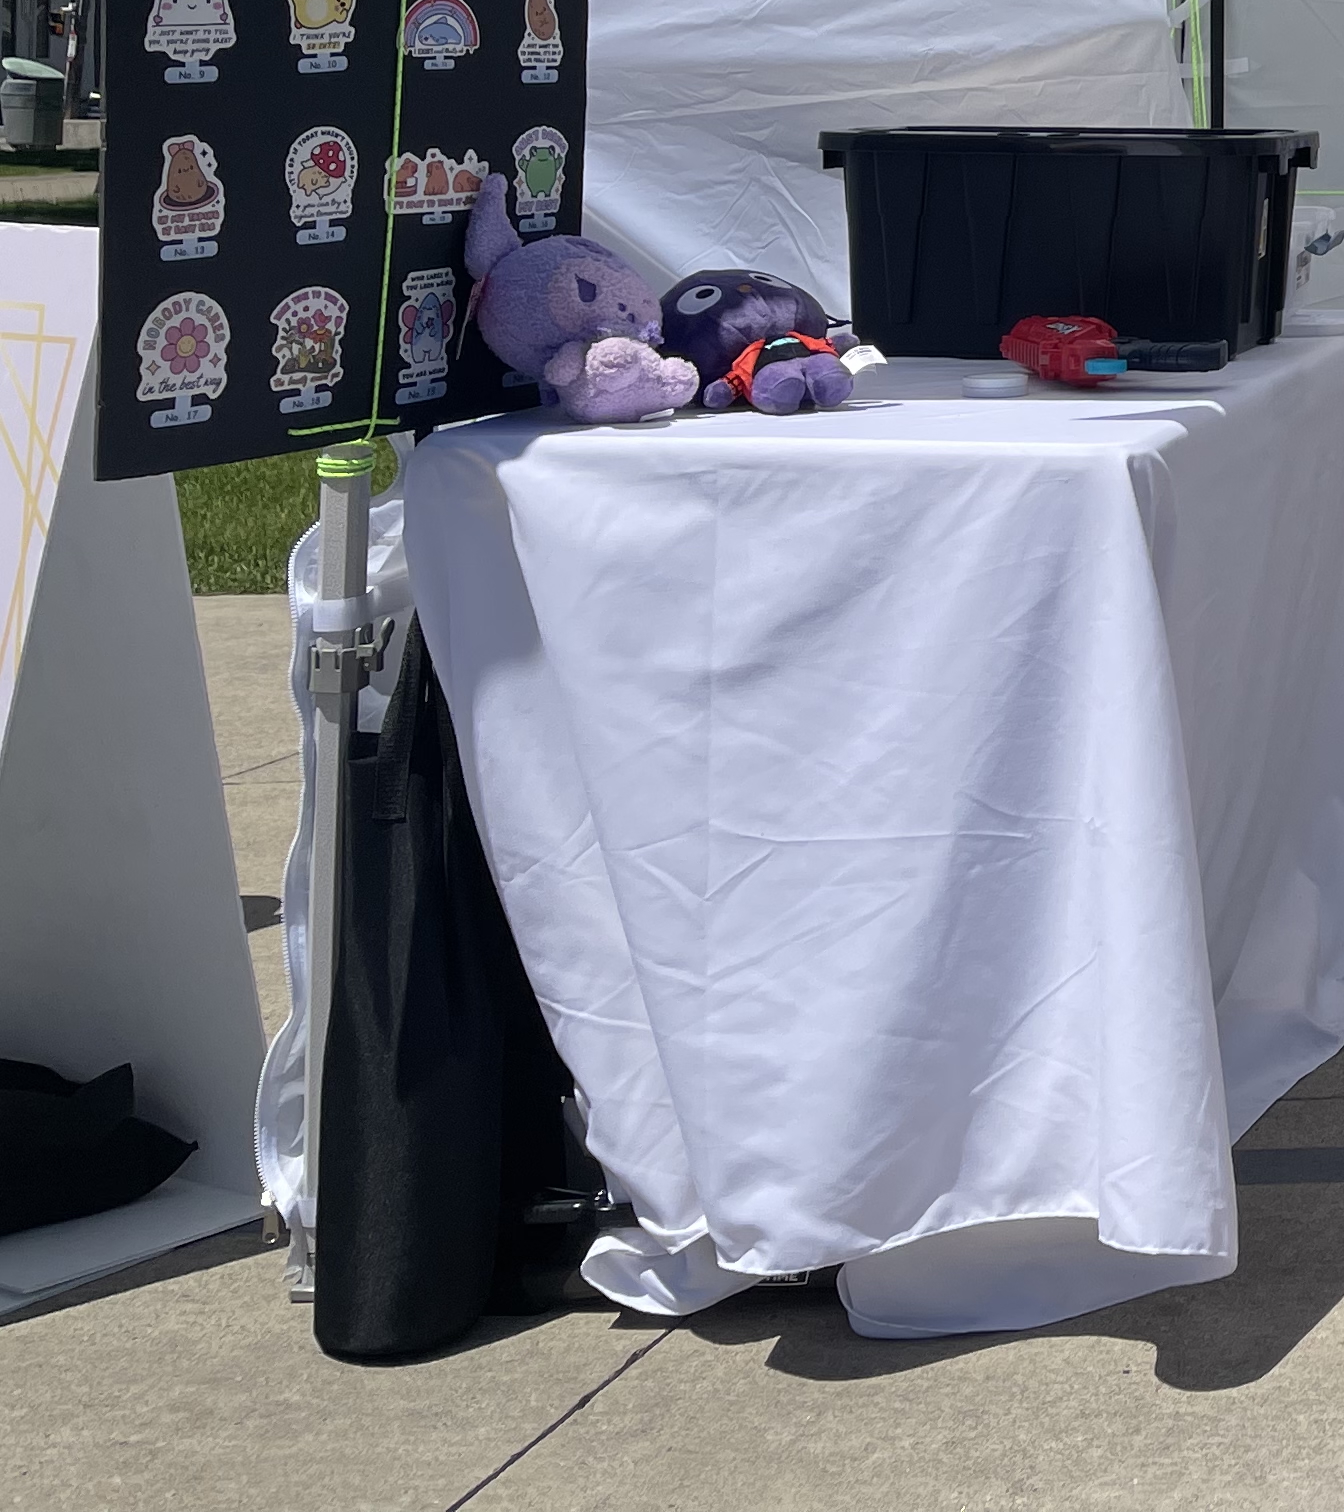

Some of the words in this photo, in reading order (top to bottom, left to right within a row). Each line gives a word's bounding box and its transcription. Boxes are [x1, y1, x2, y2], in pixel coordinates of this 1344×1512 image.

[309, 62, 322, 70] No.
[327, 60, 337, 69] 10
[178, 71, 193, 80] No.
[199, 70, 205, 79] 9
[297, 130, 319, 147] TODAY
[308, 233, 321, 241] No.
[325, 230, 335, 239] 14
[143, 297, 193, 351] NOBODY
[195, 299, 226, 344] CARES
[142, 382, 156, 396] in
[157, 376, 177, 394] the
[177, 373, 204, 391] best
[204, 377, 223, 394] way
[164, 414, 180, 424] No.
[186, 410, 199, 420] 17
